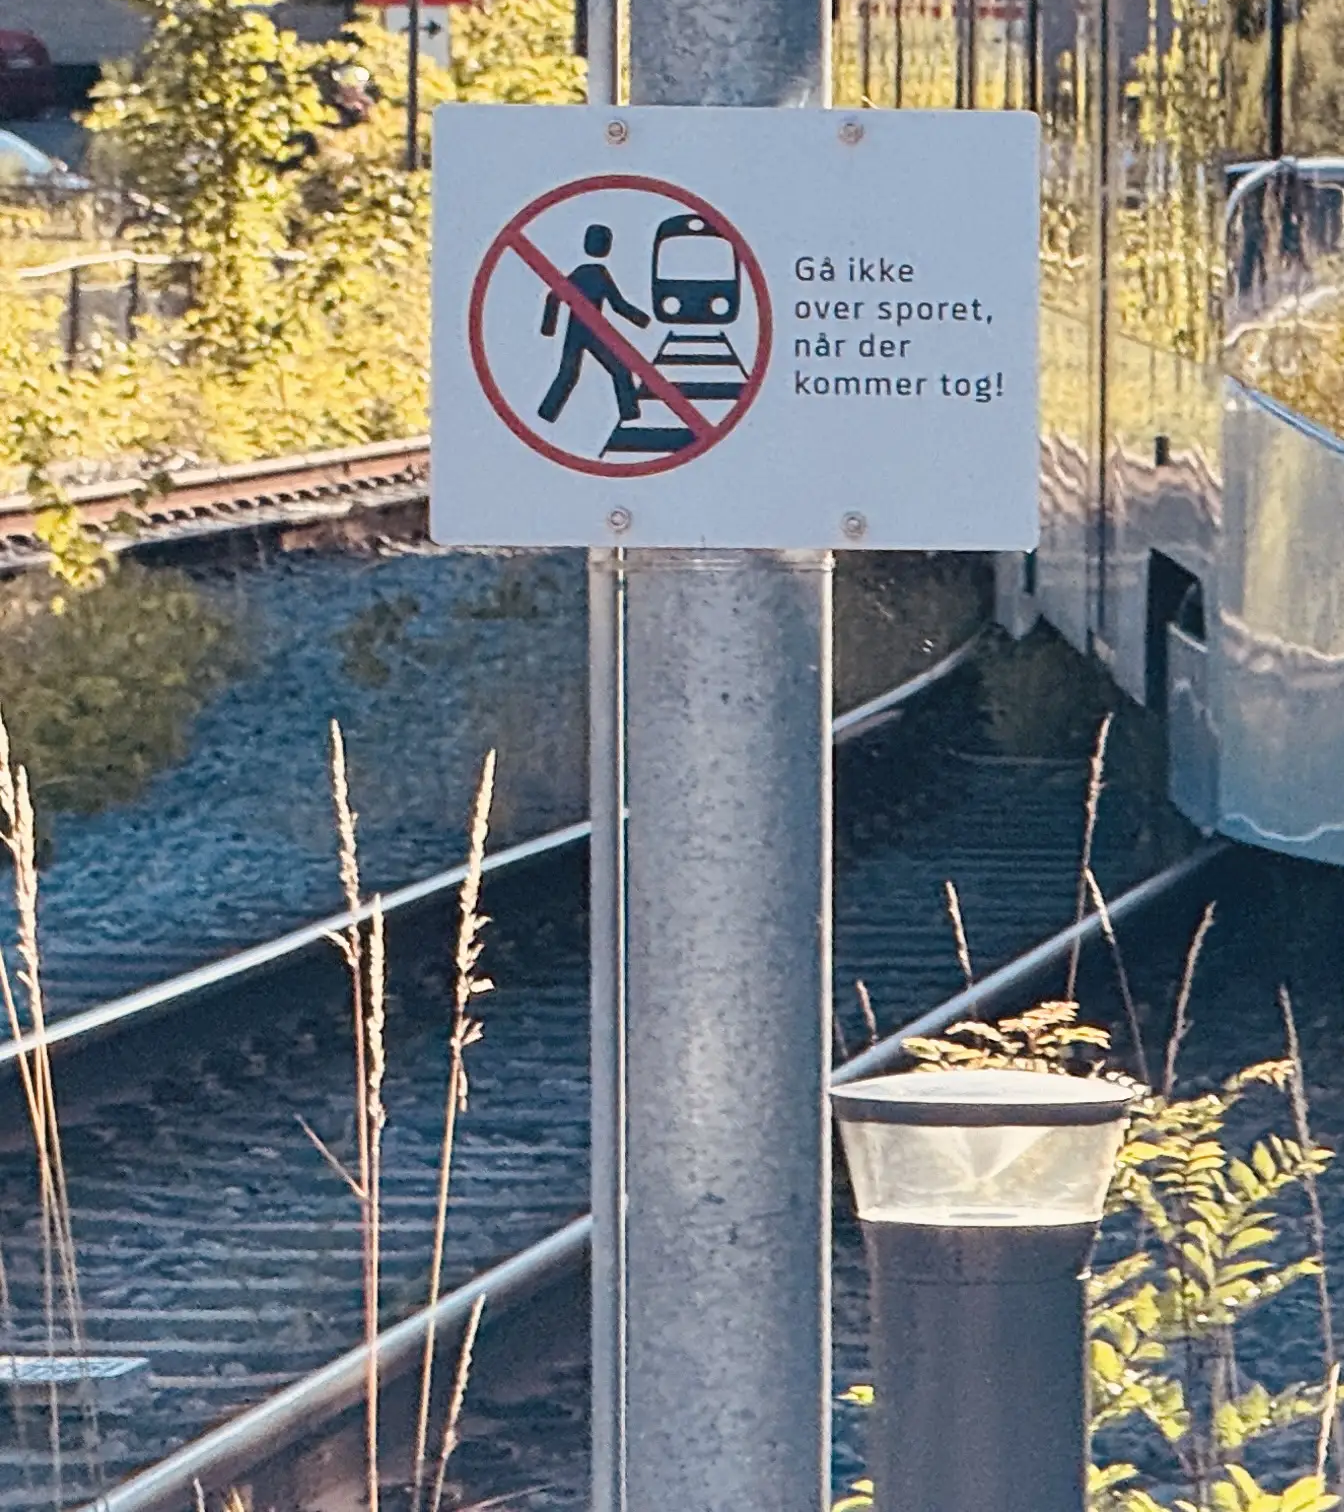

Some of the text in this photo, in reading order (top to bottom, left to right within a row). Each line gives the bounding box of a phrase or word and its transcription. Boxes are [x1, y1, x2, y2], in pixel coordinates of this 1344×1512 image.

[794, 256, 915, 284] Gå ikke
[794, 298, 994, 327] over sporet,
[794, 332, 912, 359] når der
[794, 369, 1004, 404] kommer tog!
